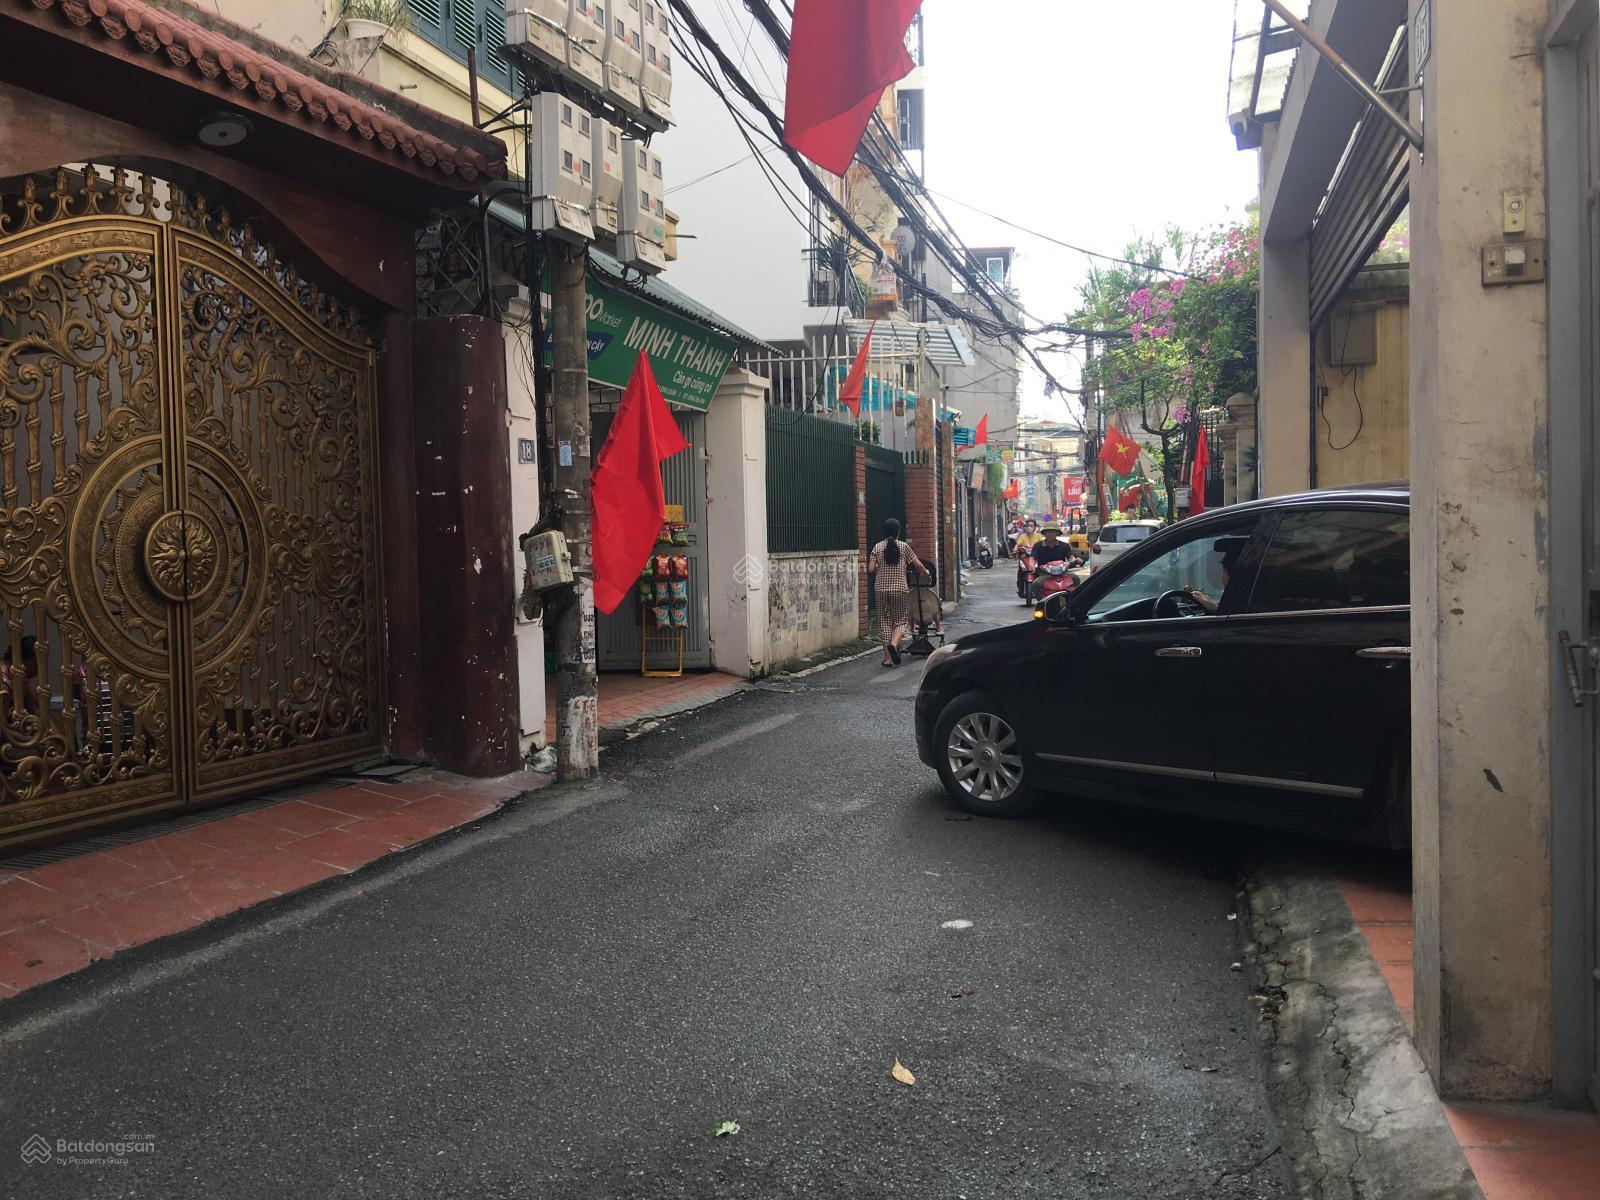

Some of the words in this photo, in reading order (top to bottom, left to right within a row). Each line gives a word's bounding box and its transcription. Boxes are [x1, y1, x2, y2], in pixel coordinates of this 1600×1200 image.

[623, 316, 675, 360] MINH
[673, 335, 728, 378] THÀNH
[521, 441, 532, 460] 18
